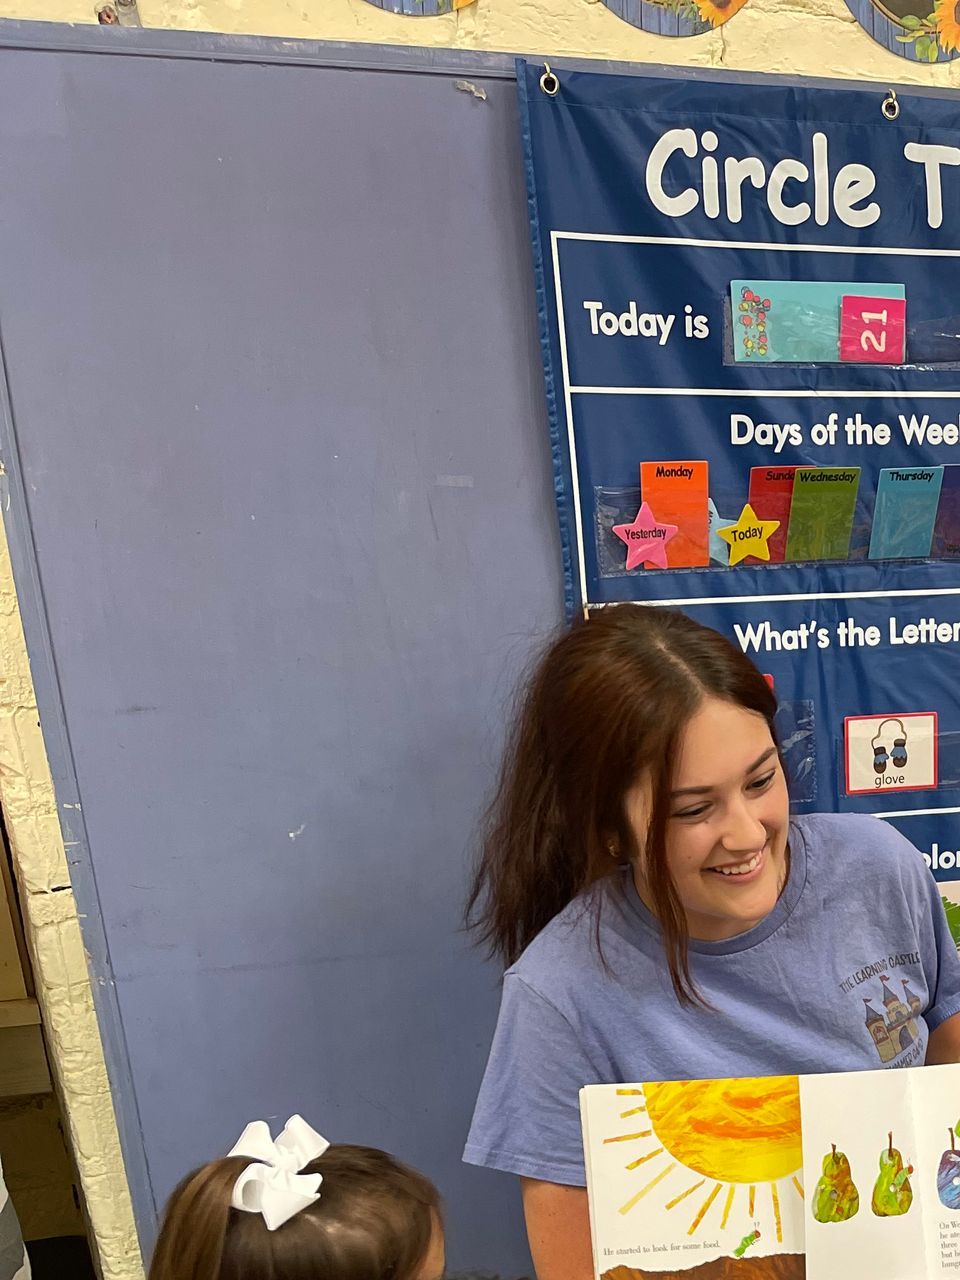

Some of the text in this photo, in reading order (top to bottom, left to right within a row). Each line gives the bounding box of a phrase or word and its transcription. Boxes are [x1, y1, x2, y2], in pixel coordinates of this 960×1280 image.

[645, 127, 881, 229] Circle
[583, 301, 709, 345] Today is
[861, 308, 889, 353] 21
[731, 414, 802, 453] Days
[811, 413, 839, 445] of
[845, 417, 891, 445] the
[656, 465, 694, 480] Monday
[765, 470, 795, 481] Sunda
[800, 471, 857, 484] Wednesday
[889, 471, 934, 482] Thursday
[624, 526, 667, 541] Yesterday
[731, 526, 764, 543] Today
[734, 620, 830, 653] What's
[838, 618, 881, 647] the
[874, 773, 905, 788] glove
[839, 977, 855, 994] THE
[852, 958, 888, 985] LEARNING
[616, 1246, 641, 1255] started
[652, 1244, 668, 1252] look
[670, 1243, 680, 1251] for
